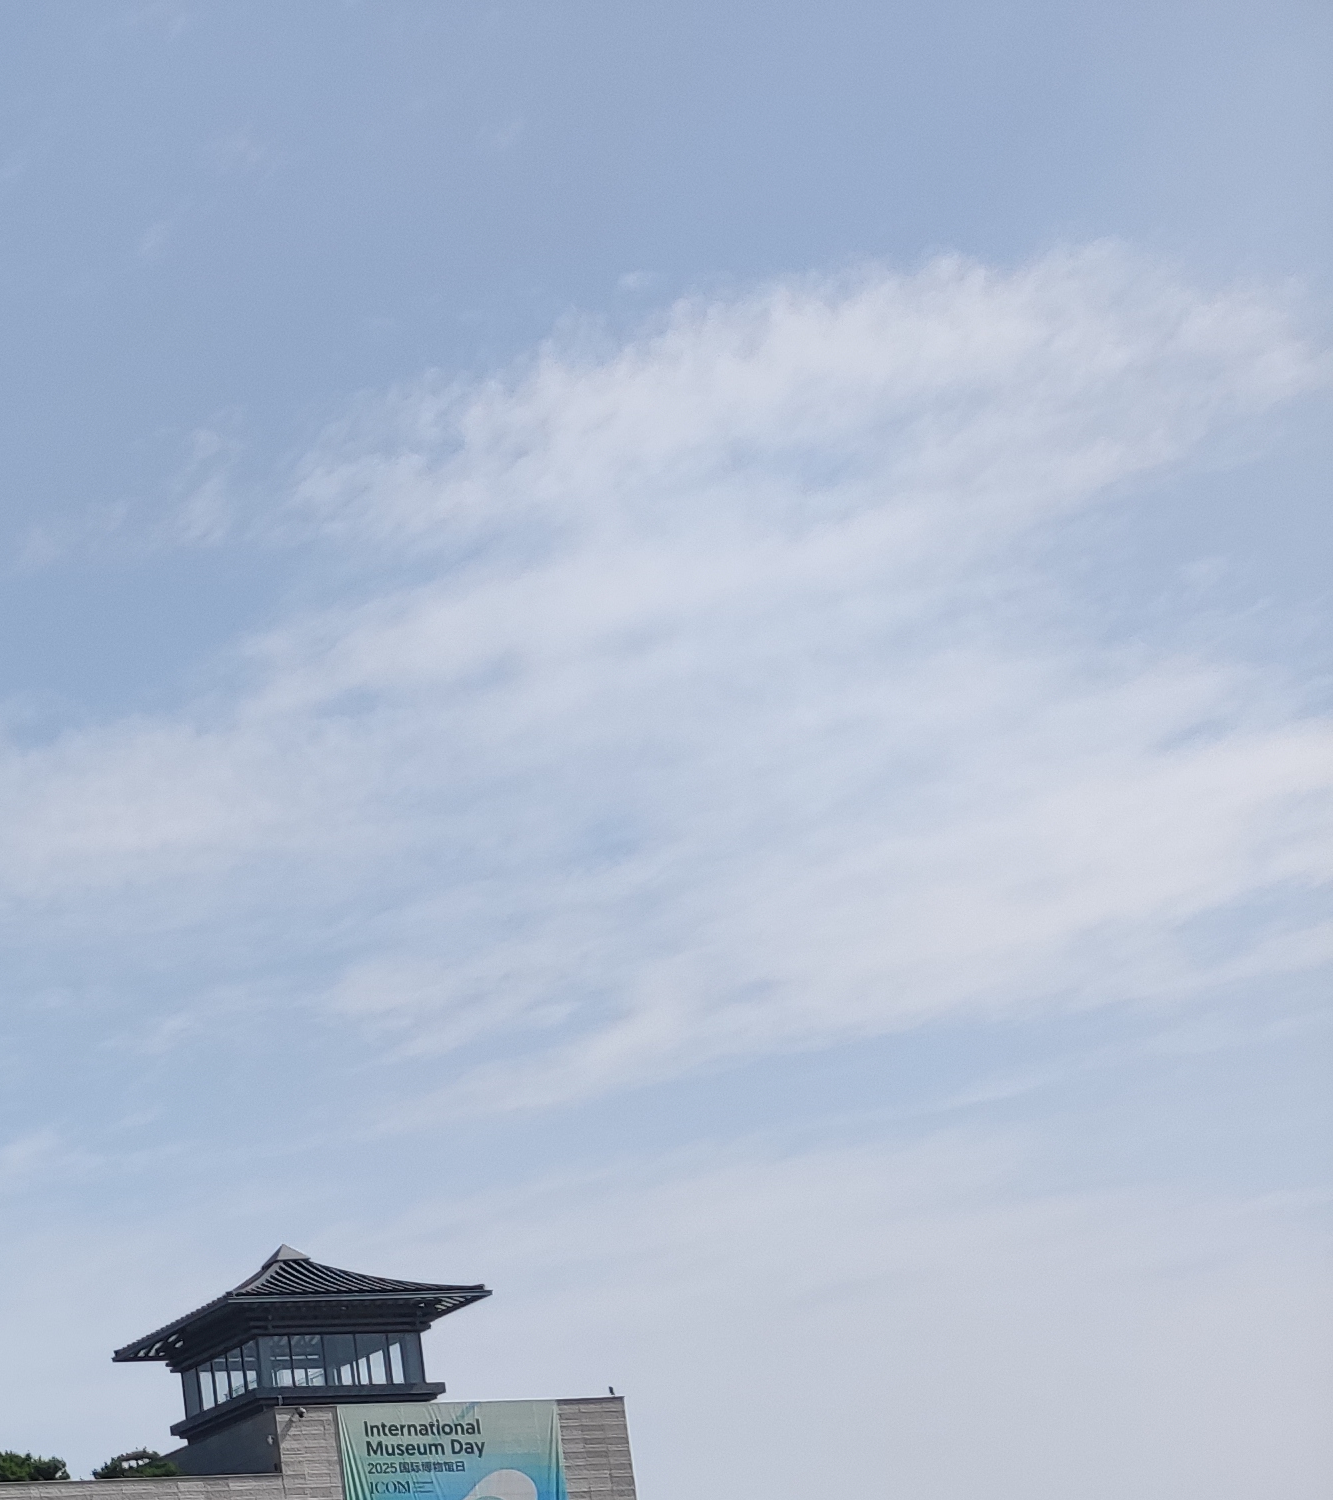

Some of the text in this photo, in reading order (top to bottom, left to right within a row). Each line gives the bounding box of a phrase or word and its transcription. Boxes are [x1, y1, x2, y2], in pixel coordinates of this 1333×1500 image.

[363, 1418, 482, 1438] International
[366, 1438, 486, 1459] Museum Day
[370, 1480, 411, 1495] ICOM
